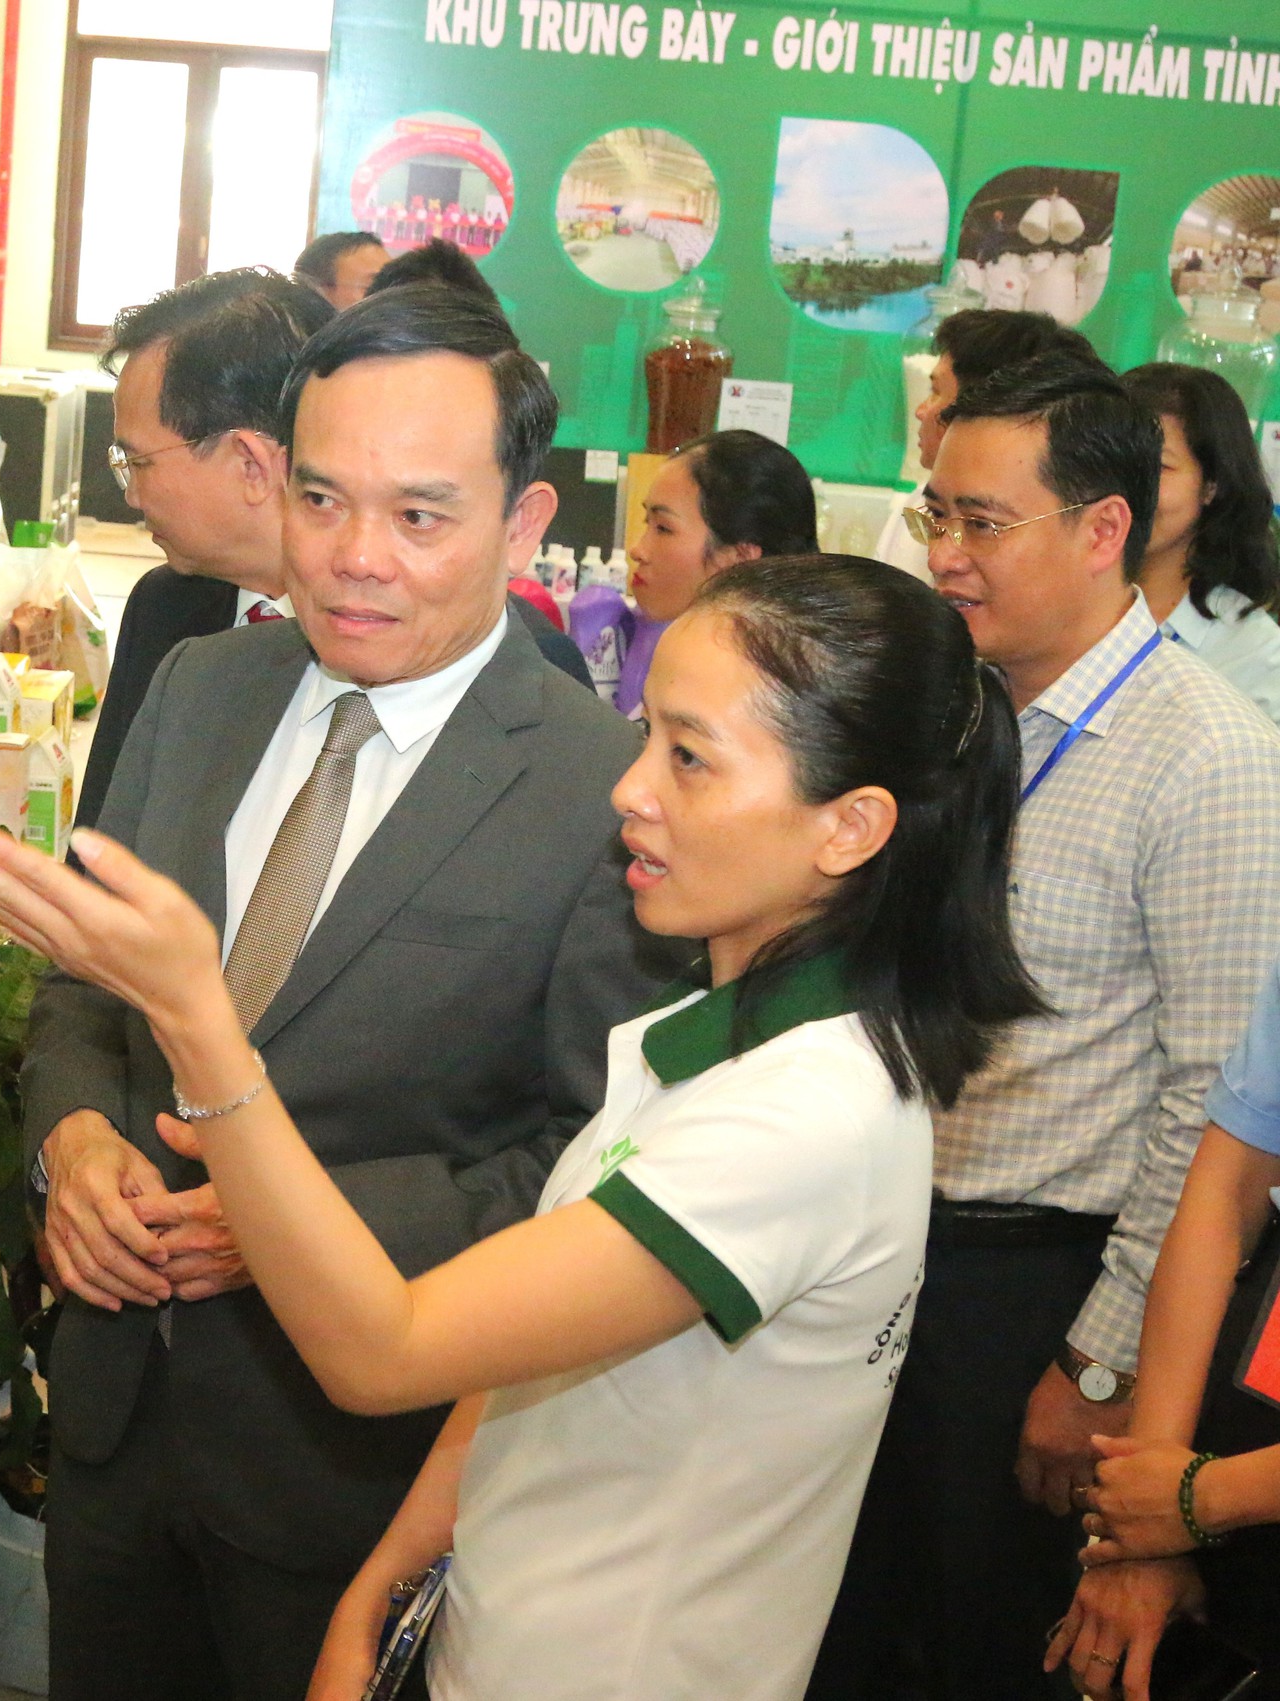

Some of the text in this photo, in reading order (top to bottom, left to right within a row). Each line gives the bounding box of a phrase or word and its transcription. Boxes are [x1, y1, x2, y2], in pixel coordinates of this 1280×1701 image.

[424, 0, 507, 48] KHU
[519, 0, 648, 59] TRƯNG
[658, 0, 736, 65] BÀY
[772, 8, 859, 74] GIỚI
[871, 17, 981, 95] THIỆU
[988, 20, 1069, 90] SẢN
[1077, 24, 1191, 100] PHẨM
